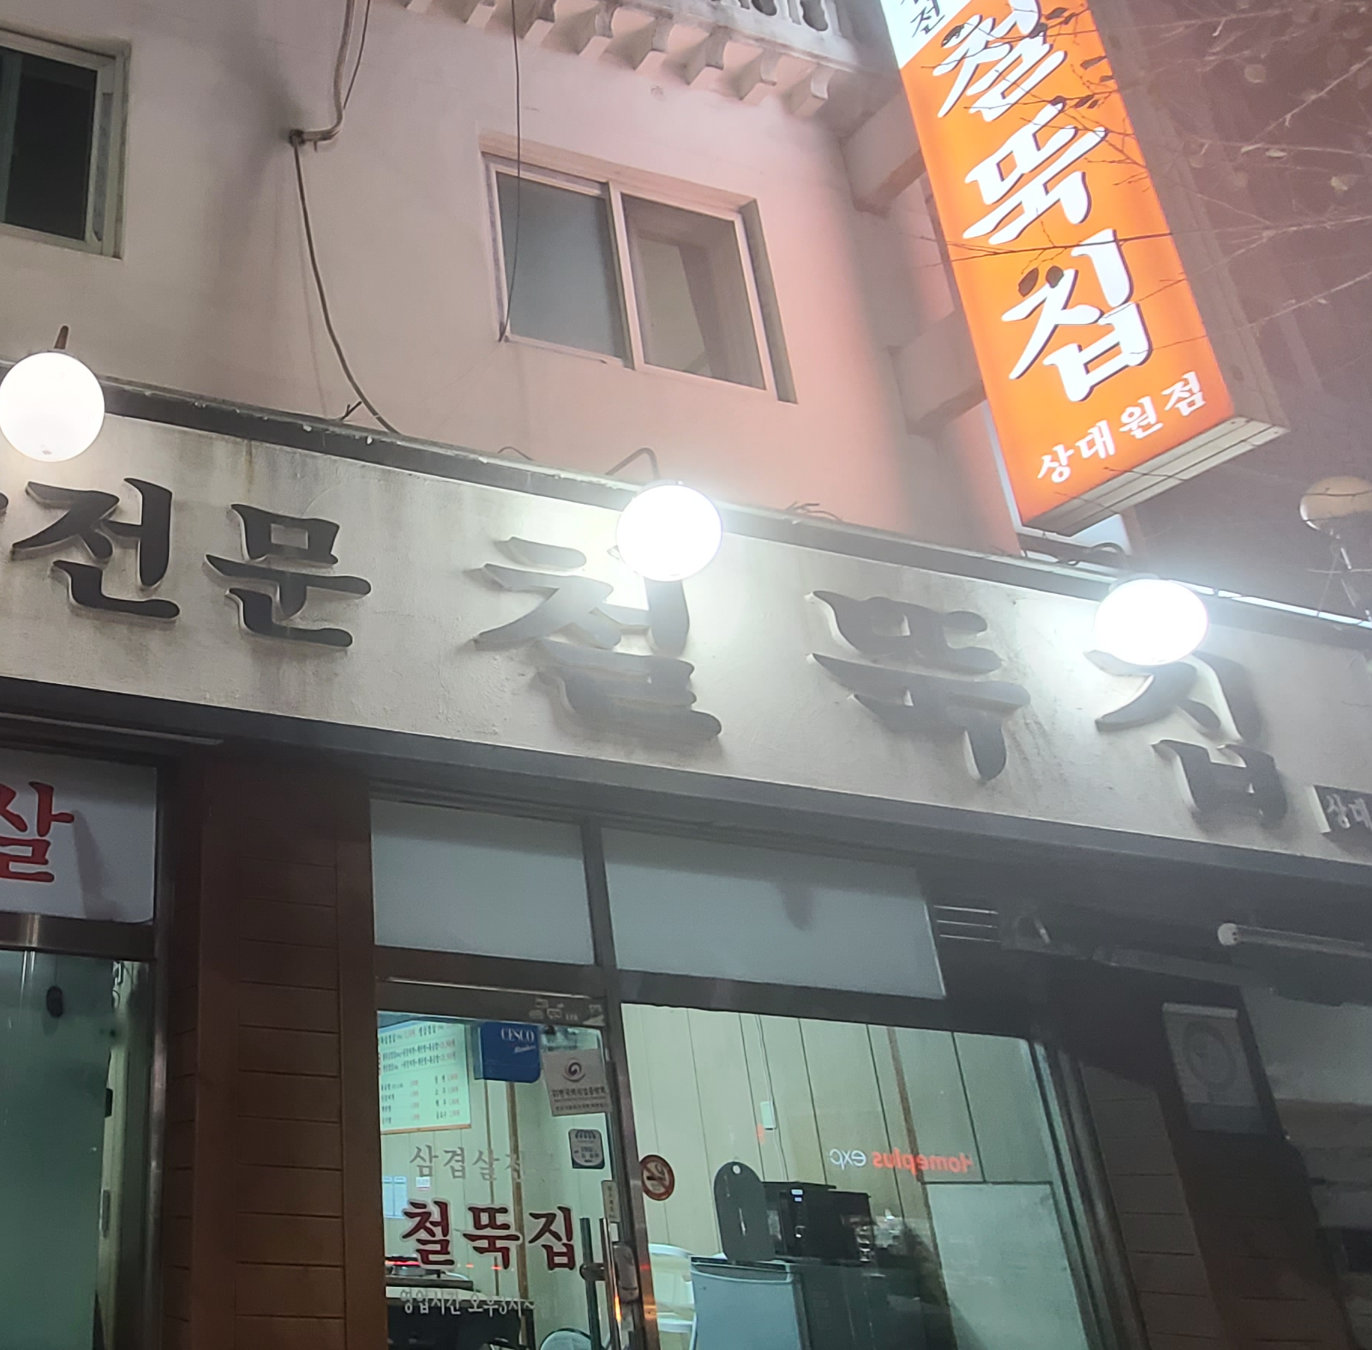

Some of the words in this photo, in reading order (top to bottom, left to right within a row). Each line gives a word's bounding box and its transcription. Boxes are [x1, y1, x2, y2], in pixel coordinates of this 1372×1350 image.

[932, 0, 1151, 402] 철뚝집
[1036, 371, 1207, 484] 상대원점
[501, 1028, 534, 1043] CESCO
[401, 1200, 576, 1271] 철뚝집
[400, 1289, 462, 1316] 영업시간
